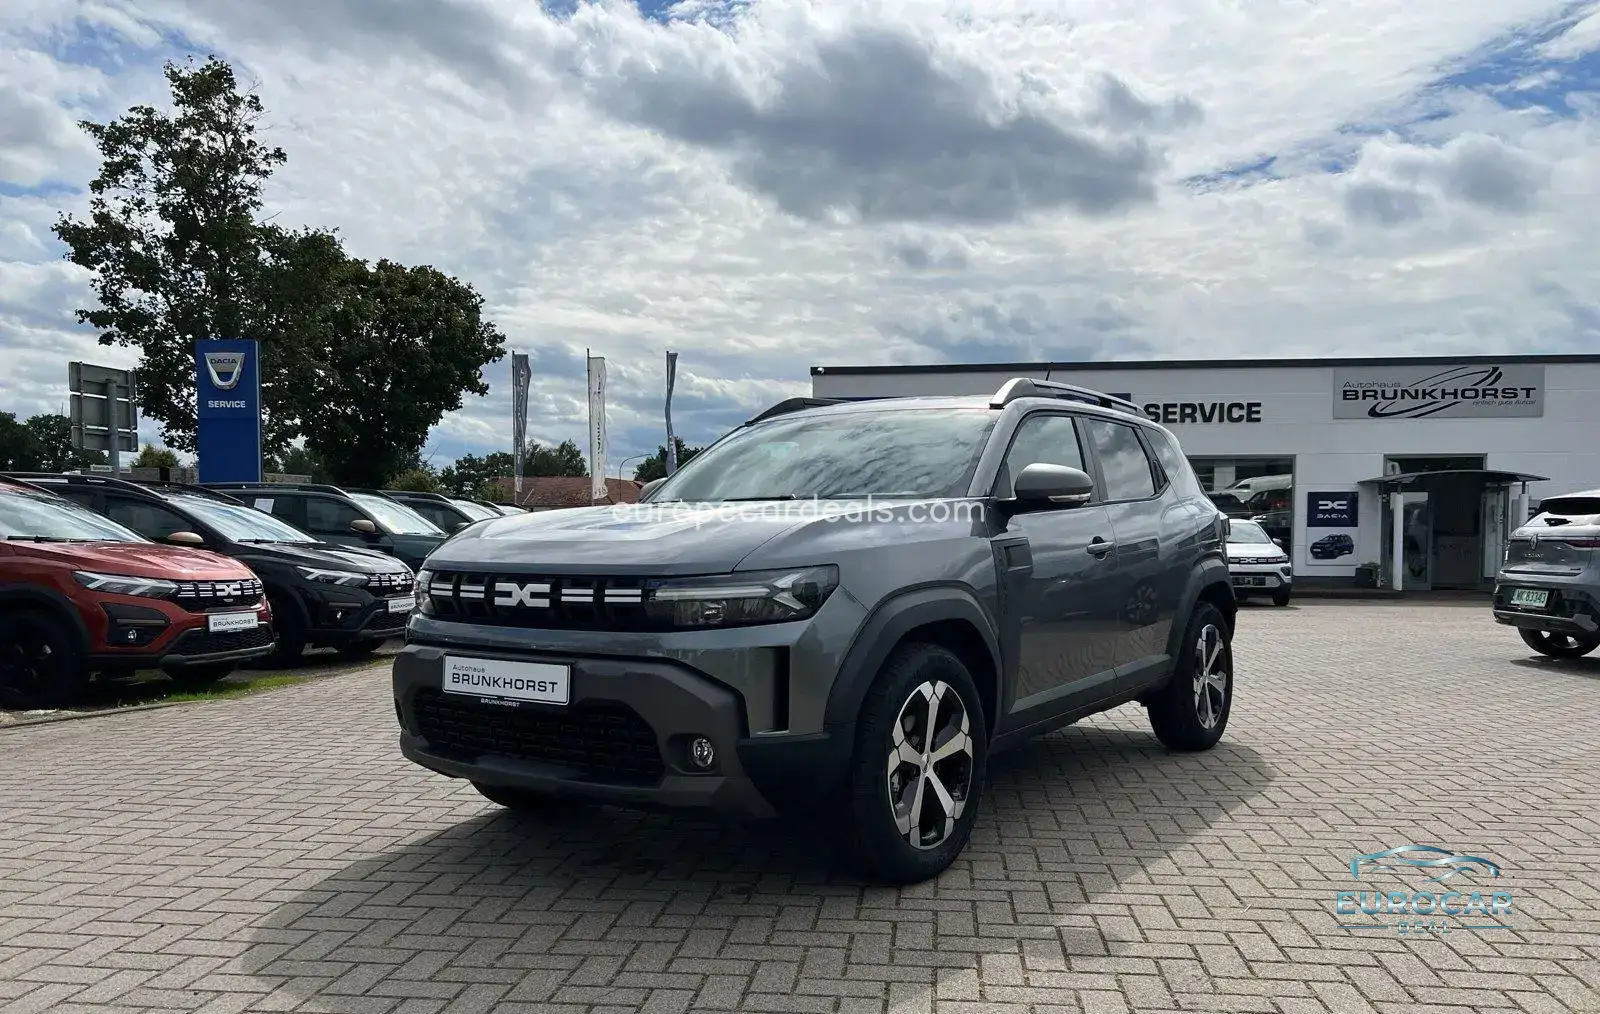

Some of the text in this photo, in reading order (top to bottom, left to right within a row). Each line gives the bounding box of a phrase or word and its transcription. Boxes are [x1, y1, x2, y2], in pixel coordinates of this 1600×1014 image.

[1342, 387, 1537, 401] BRUNKHORST
[208, 400, 246, 408] SERVICE
[1143, 402, 1262, 424] SERVICE
[213, 618, 255, 627] BRUNKHORST
[452, 664, 486, 673] Autohaus
[451, 672, 558, 693] BRUNKHORST
[480, 698, 521, 707] BRUNKHORST
